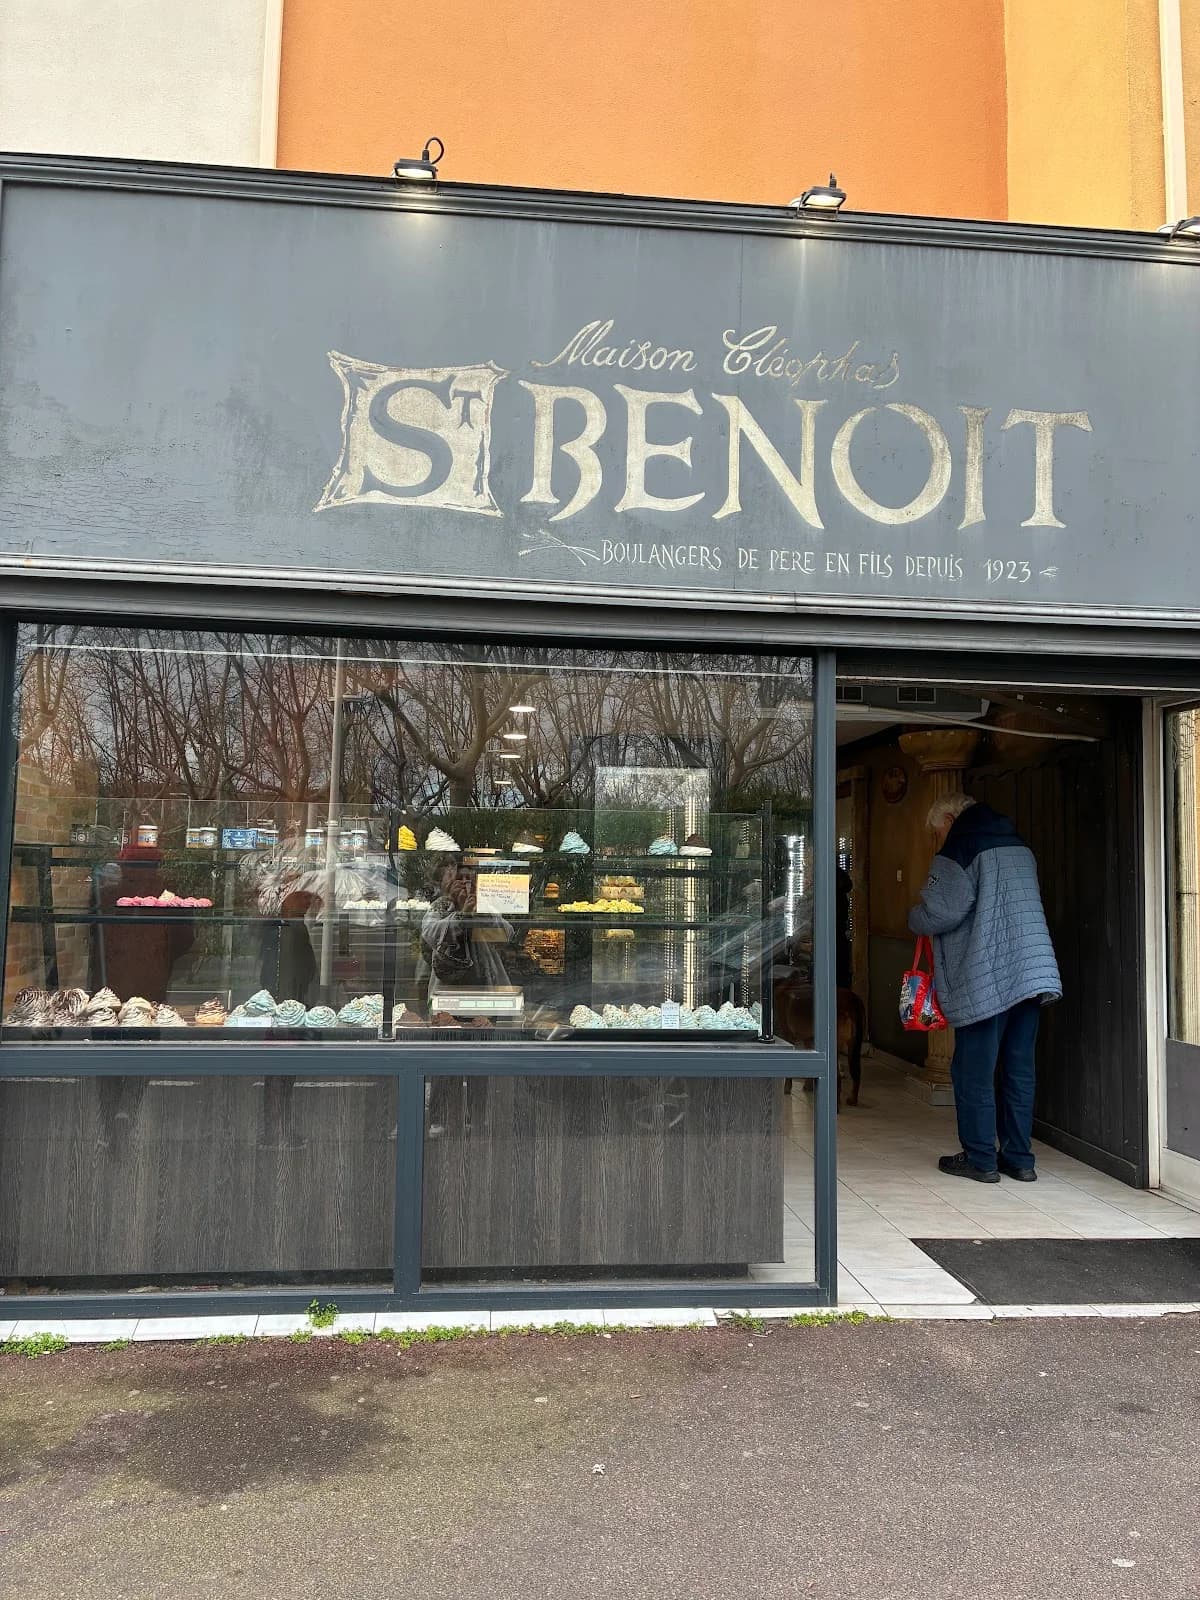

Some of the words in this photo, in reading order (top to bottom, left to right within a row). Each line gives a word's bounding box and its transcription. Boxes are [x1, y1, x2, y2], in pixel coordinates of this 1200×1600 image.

[531, 319, 698, 372] Maison
[518, 379, 1093, 529] BENOIT
[601, 539, 722, 571] BOULANGERS
[738, 547, 760, 569] DE
[825, 552, 850, 573] EN
[984, 559, 1032, 584] 1923
